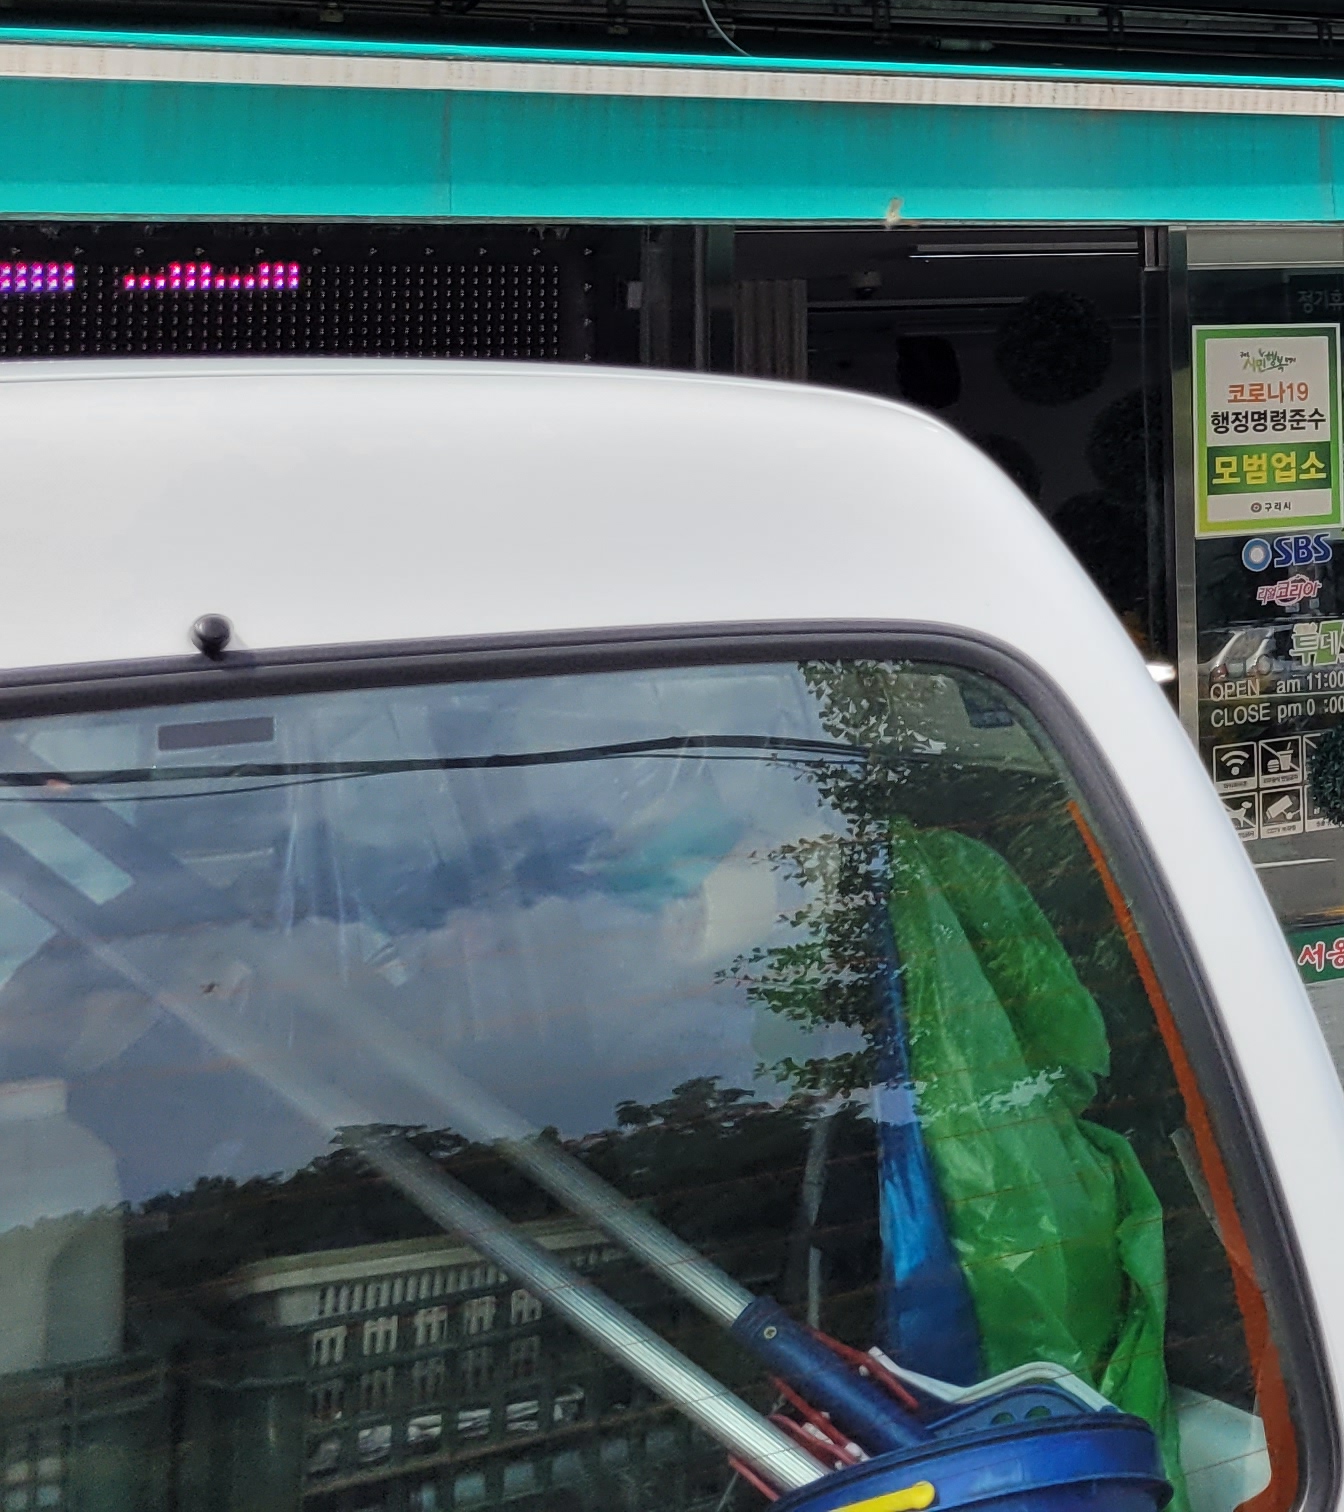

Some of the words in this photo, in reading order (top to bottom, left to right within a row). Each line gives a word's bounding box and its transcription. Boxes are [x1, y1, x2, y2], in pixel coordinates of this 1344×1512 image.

[1227, 381, 1309, 405] 코로나19
[1211, 408, 1327, 434] 행정명령준수
[1212, 451, 1328, 486] 모범업소
[1264, 500, 1292, 512] 구리시
[1273, 533, 1333, 567] SBS
[1210, 678, 1260, 701] OPEN
[1276, 678, 1300, 693] am
[1211, 703, 1271, 728] CLOSE
[1278, 703, 1302, 724] pm
